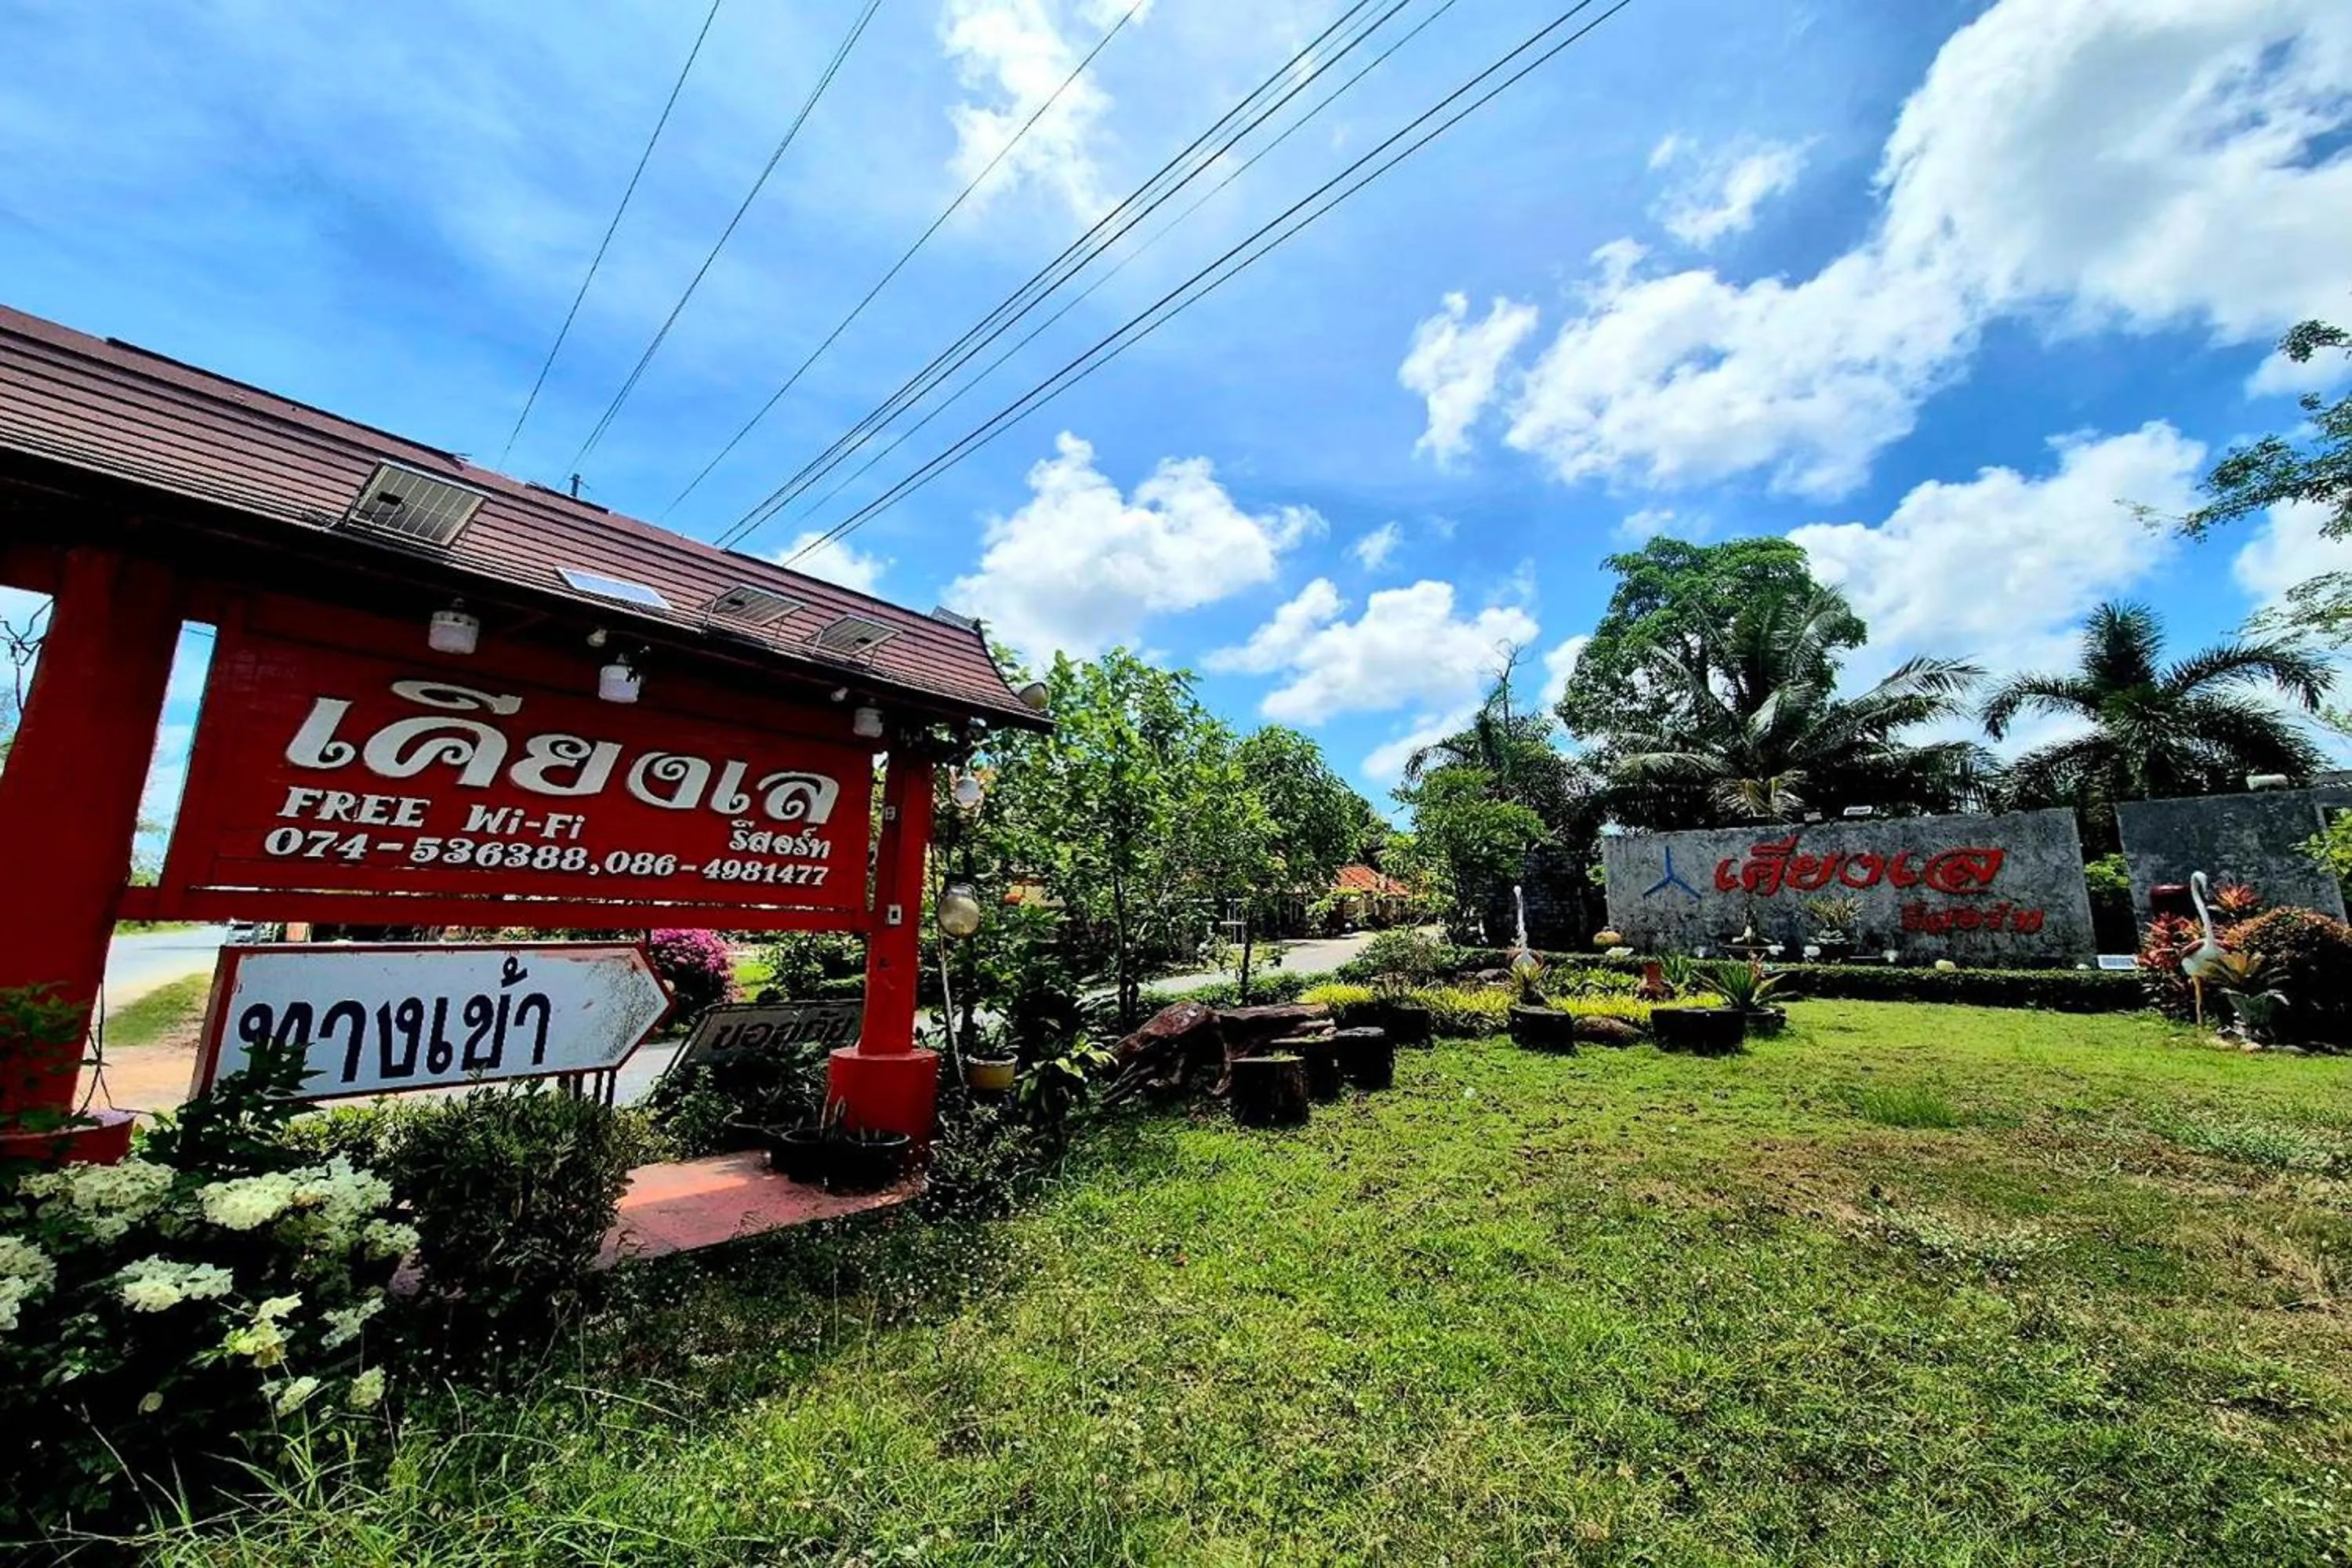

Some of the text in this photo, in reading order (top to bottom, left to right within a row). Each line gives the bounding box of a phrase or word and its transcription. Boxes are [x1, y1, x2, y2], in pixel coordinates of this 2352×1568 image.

[285, 680, 840, 824] เคียงเล
[276, 786, 586, 840] FREE Wi-Fi
[728, 819, 832, 859] รีสอร์ท
